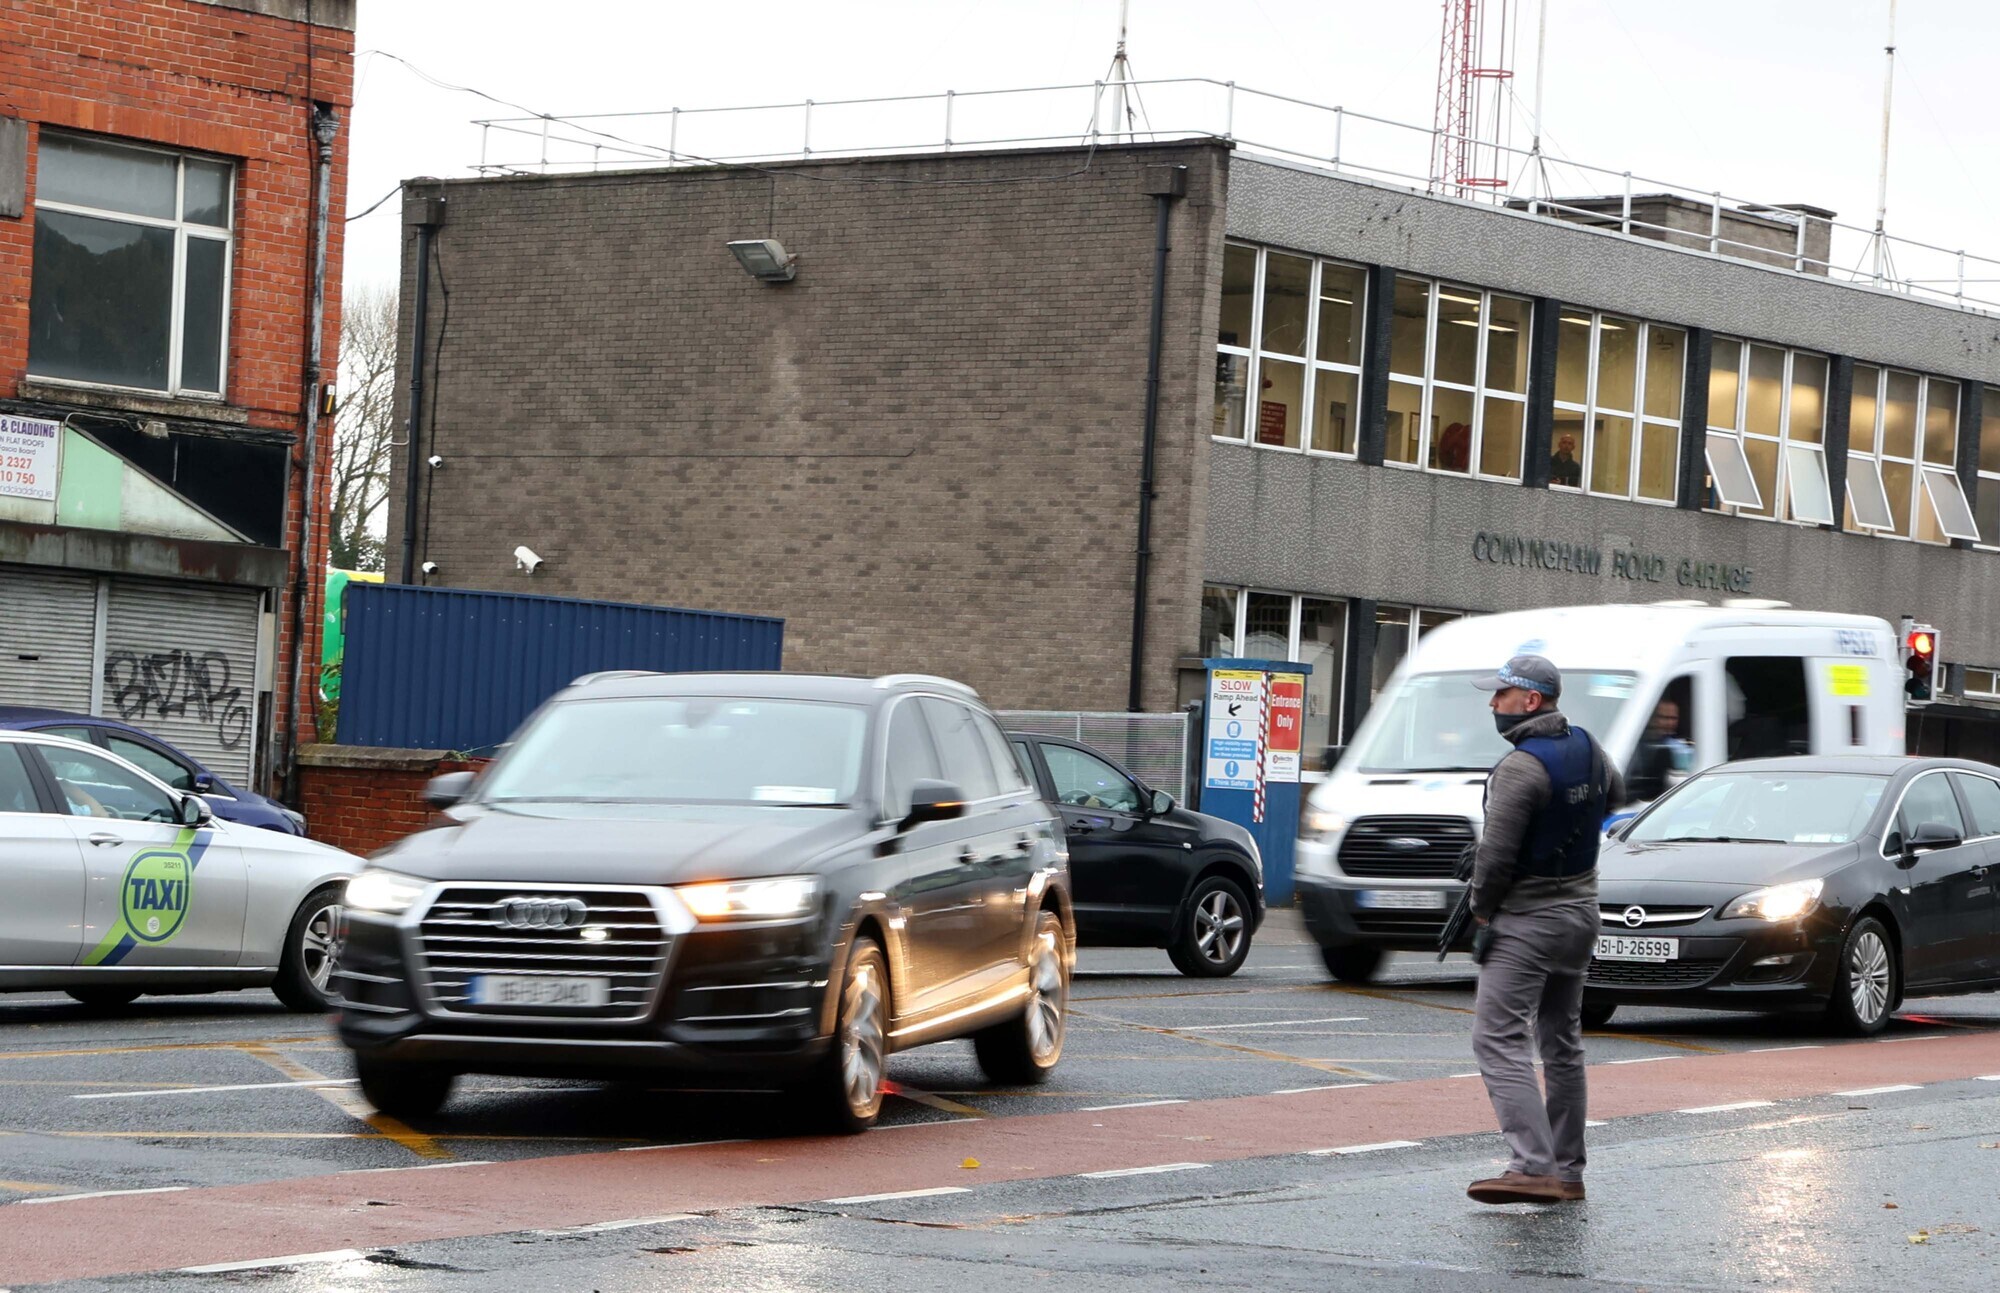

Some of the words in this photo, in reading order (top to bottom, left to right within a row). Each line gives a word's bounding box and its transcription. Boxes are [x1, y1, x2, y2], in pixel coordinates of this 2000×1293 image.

[1, 419, 8, 432] &
[11, 420, 55, 438] CLADDING
[6, 436, 20, 445] FLAT
[22, 439, 45, 448] ROOFS
[19, 447, 37, 455] Board
[7, 456, 32, 469] 2327
[16, 472, 35, 484] 750
[1612, 548, 1665, 582] ROAD
[1677, 558, 1753, 594] GARAGE
[1220, 680, 1252, 691] SLOW
[1213, 693, 1234, 702] Ramp
[1236, 694, 1259, 702] Ahead
[1271, 694, 1301, 708] Entrance
[1277, 714, 1294, 730] Only
[1231, 780, 1249, 788] Safety
[131, 878, 182, 911] TAXI
[1597, 939, 1671, 956] 151-D-26599
